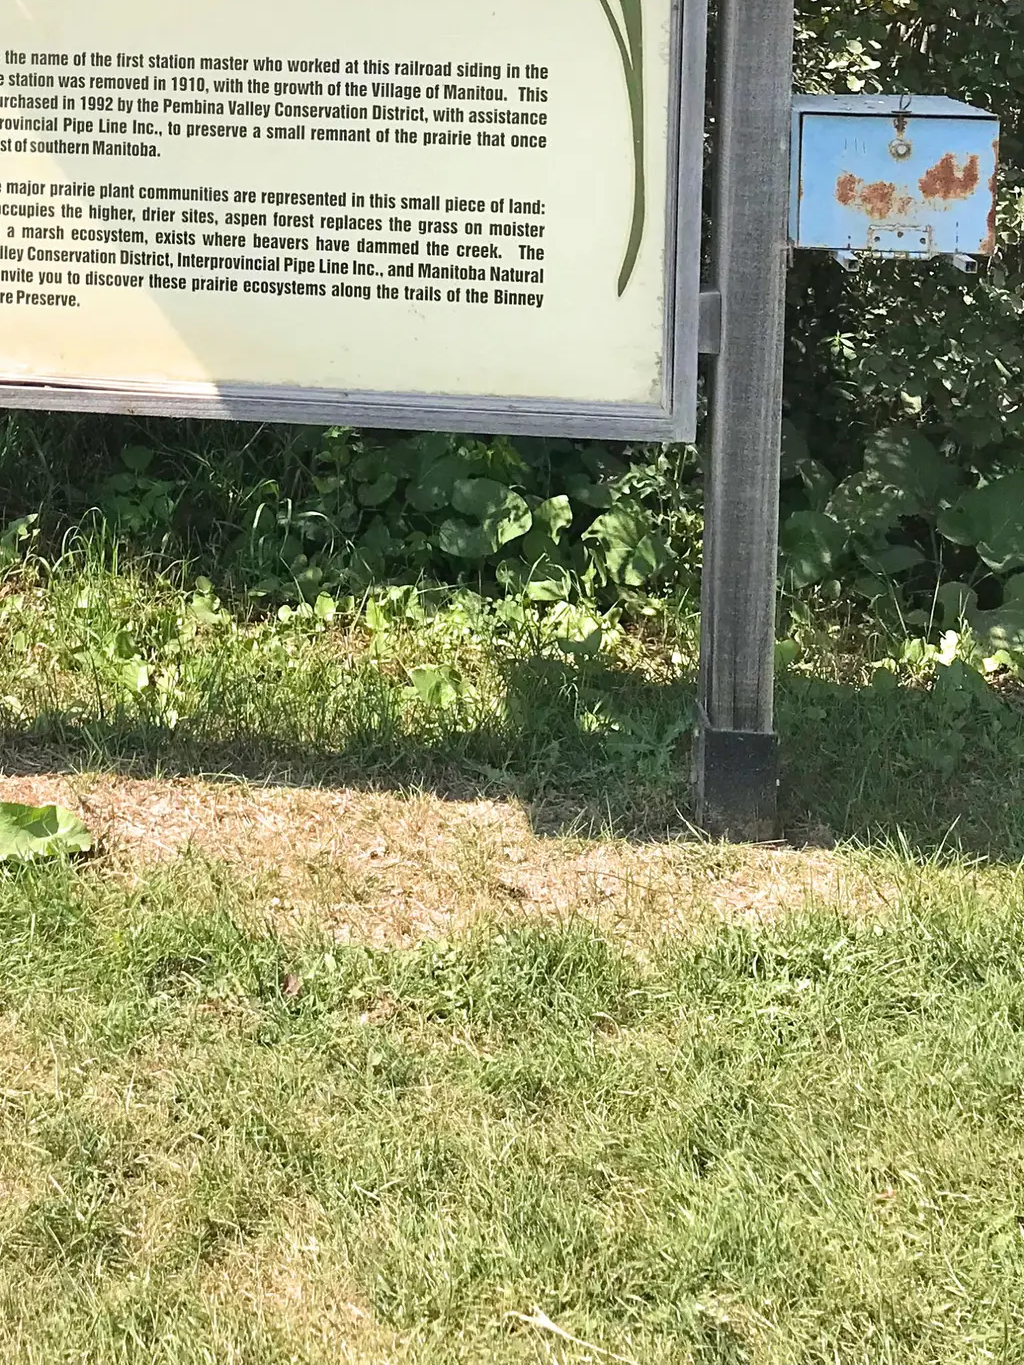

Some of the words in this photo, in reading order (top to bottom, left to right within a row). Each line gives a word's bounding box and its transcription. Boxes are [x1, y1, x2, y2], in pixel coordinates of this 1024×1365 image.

[4, 49, 26, 65] the
[30, 53, 69, 66] name
[72, 51, 87, 67] of
[89, 52, 112, 67] the
[115, 52, 144, 69] first
[147, 54, 195, 70] station
[199, 56, 249, 71] master
[252, 56, 283, 72] who
[286, 58, 340, 74] worked
[344, 59, 359, 75] at
[362, 59, 390, 75] this
[393, 60, 452, 77] railroad
[455, 62, 501, 80] siding
[505, 63, 520, 79] in
[524, 63, 549, 80] the
[7, 72, 54, 88] station
[57, 75, 86, 89] was
[88, 75, 149, 91] removed
[152, 75, 166, 91] in
[170, 76, 209, 94] 1910,
[212, 77, 243, 94] with
[246, 78, 270, 94] the
[273, 80, 323, 97] growth
[326, 81, 342, 97] of
[343, 81, 368, 97] the
[370, 82, 421, 101] Village
[424, 84, 440, 100] of
[442, 84, 508, 102] Manitou.
[517, 86, 548, 103] This
[61, 95, 75, 111] in
[79, 95, 114, 112] 1992
[116, 96, 134, 114] by
[135, 97, 159, 113] the
[162, 98, 224, 115] Pembina
[227, 100, 271, 119] Valley
[273, 101, 368, 120] Conservation
[371, 104, 429, 124] District,
[431, 107, 464, 123] with
[467, 108, 548, 126] assistance
[5, 180, 46, 197] major
[49, 181, 95, 198] prairie
[98, 182, 135, 200] plant
[137, 186, 229, 203] communities
[232, 190, 257, 204] are
[260, 191, 347, 207] represented
[350, 192, 365, 208] in
[368, 193, 396, 209] this
[399, 195, 440, 211] small
[444, 196, 486, 213] piece
[489, 198, 505, 214] of
[508, 198, 545, 215] land:
[60, 203, 83, 219] the
[88, 204, 136, 223] higher,
[141, 206, 176, 223] drier
[180, 208, 219, 226] sites,
[223, 212, 267, 228] aspen
[272, 211, 314, 229] forest
[319, 214, 383, 231] replaces
[387, 216, 412, 233] the
[417, 220, 458, 235] grass
[463, 222, 482, 235] on
[488, 221, 545, 238] moister
[6, 226, 15, 238] a
[21, 225, 64, 240] marsh
[70, 228, 148, 246] ecosystem,
[154, 229, 196, 246] exists
[201, 231, 246, 248] where
[252, 233, 309, 251] beavers
[315, 235, 350, 253] have
[356, 237, 419, 256] dammed
[425, 240, 449, 257] the
[455, 243, 502, 259] creek.
[517, 244, 545, 261] The
[26, 246, 116, 265] Conservation
[119, 249, 174, 269] District,
[176, 252, 280, 272] Interprovincial
[283, 256, 315, 275] Pipe
[318, 258, 349, 275] Line
[351, 259, 384, 278] Inc.,
[386, 262, 414, 278] and
[417, 262, 486, 281] Manitoba
[489, 266, 544, 284] Natural
[15, 289, 80, 307] Preserve.
[37, 271, 62, 285] you
[66, 270, 80, 285] to
[84, 270, 144, 288] discover
[147, 273, 187, 290] these
[190, 276, 238, 292] prairie
[242, 280, 327, 297] ecosystems
[330, 281, 371, 301] along
[375, 283, 399, 300] the
[403, 285, 442, 302] trails
[445, 287, 461, 303] of
[464, 288, 489, 304] the
[493, 289, 544, 309] Binney
